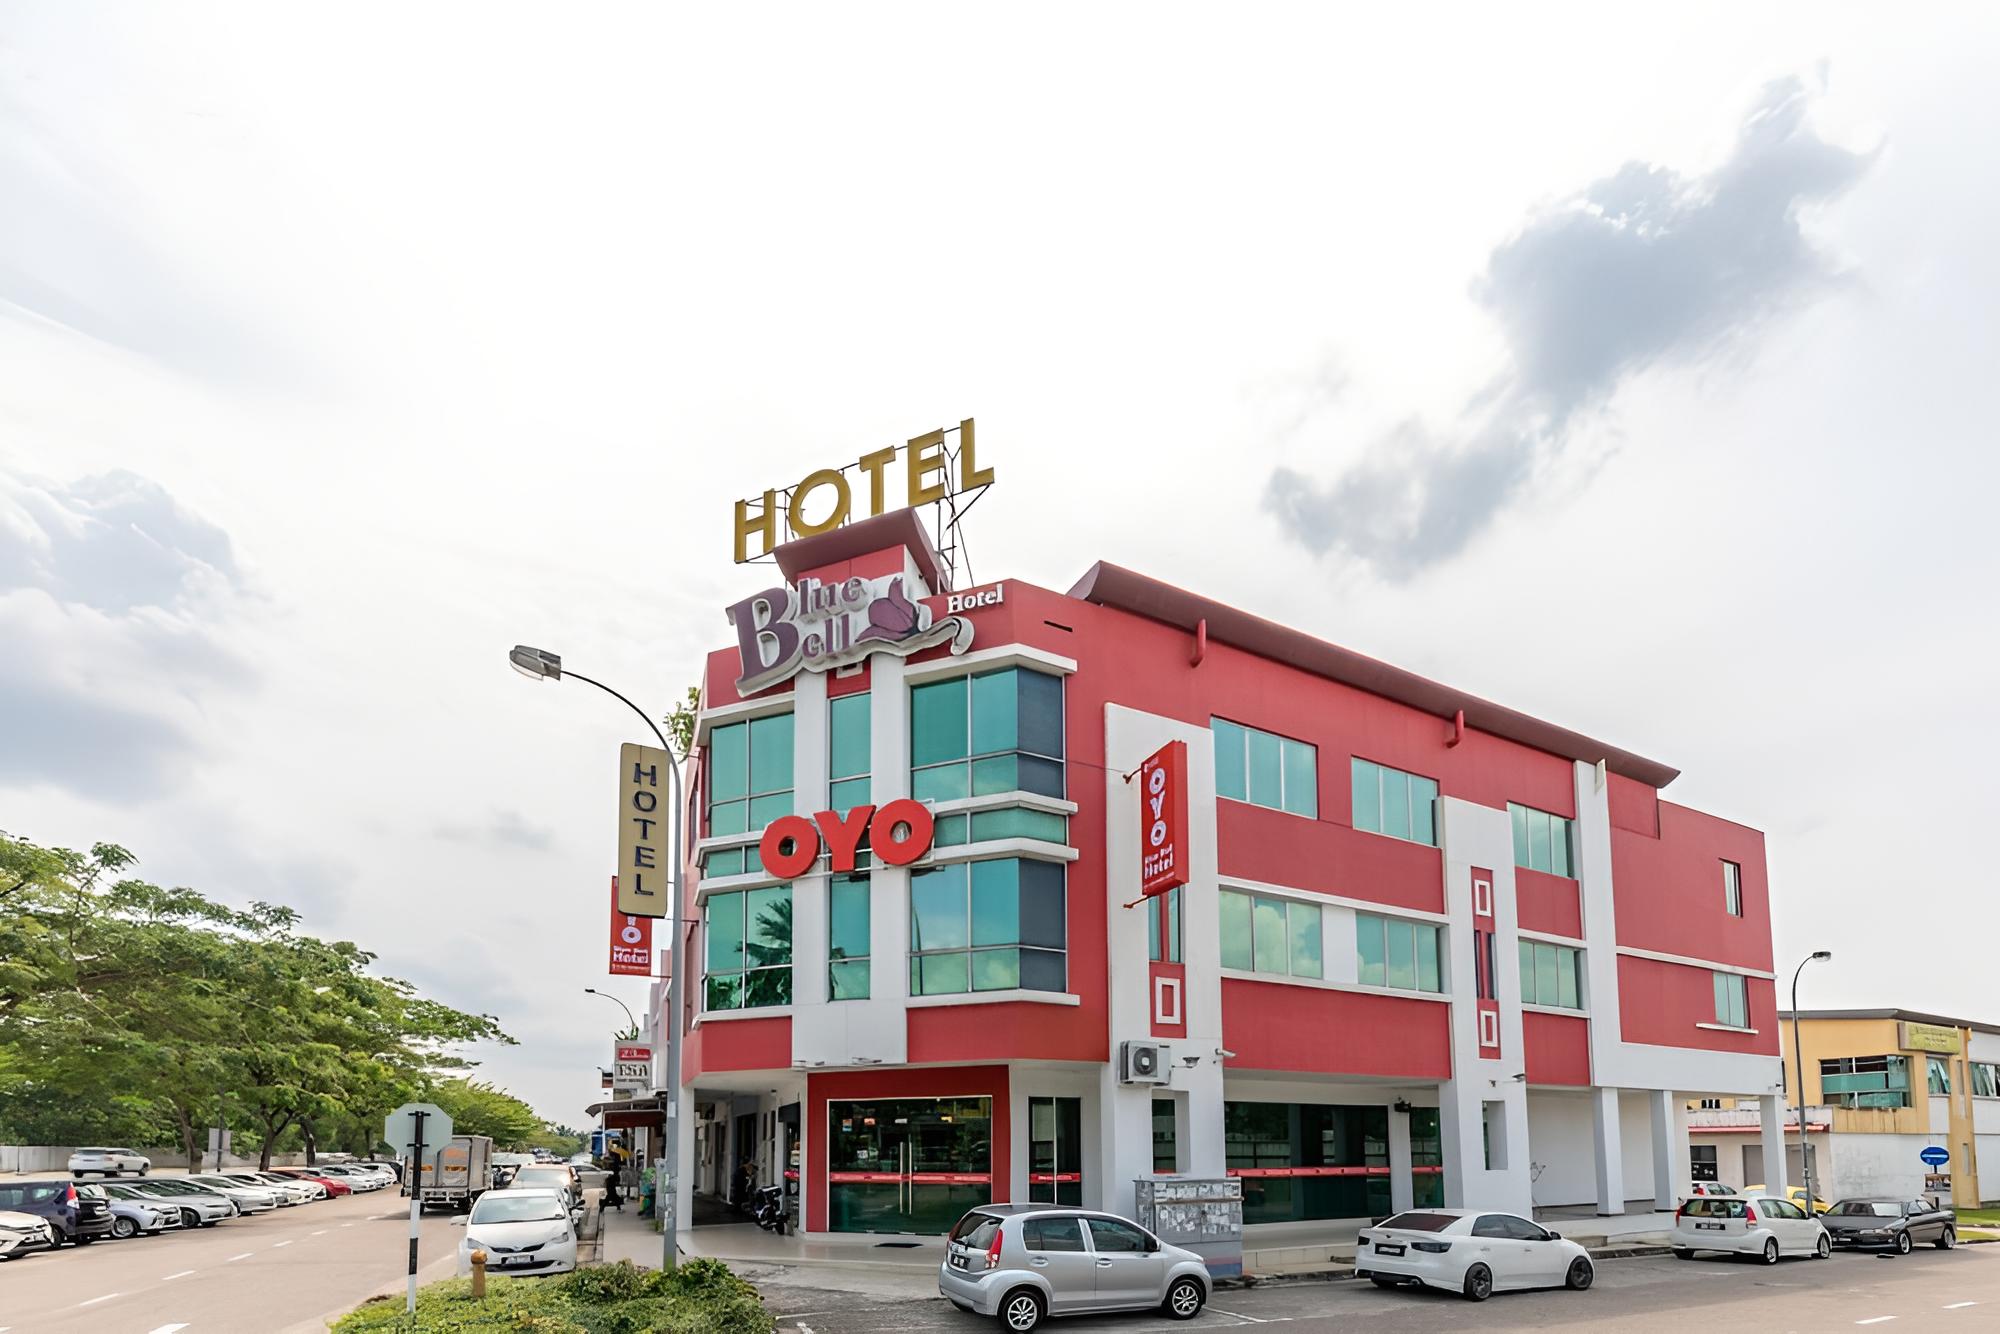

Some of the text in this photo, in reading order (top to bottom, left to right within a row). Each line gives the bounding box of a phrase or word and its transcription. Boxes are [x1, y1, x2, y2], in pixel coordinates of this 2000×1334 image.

[734, 418, 994, 563] HOTEL
[947, 583, 1003, 614] Hotel
[633, 763, 657, 896] HOTEL
[759, 799, 934, 879] OYO
[1149, 768, 1167, 846] OYO
